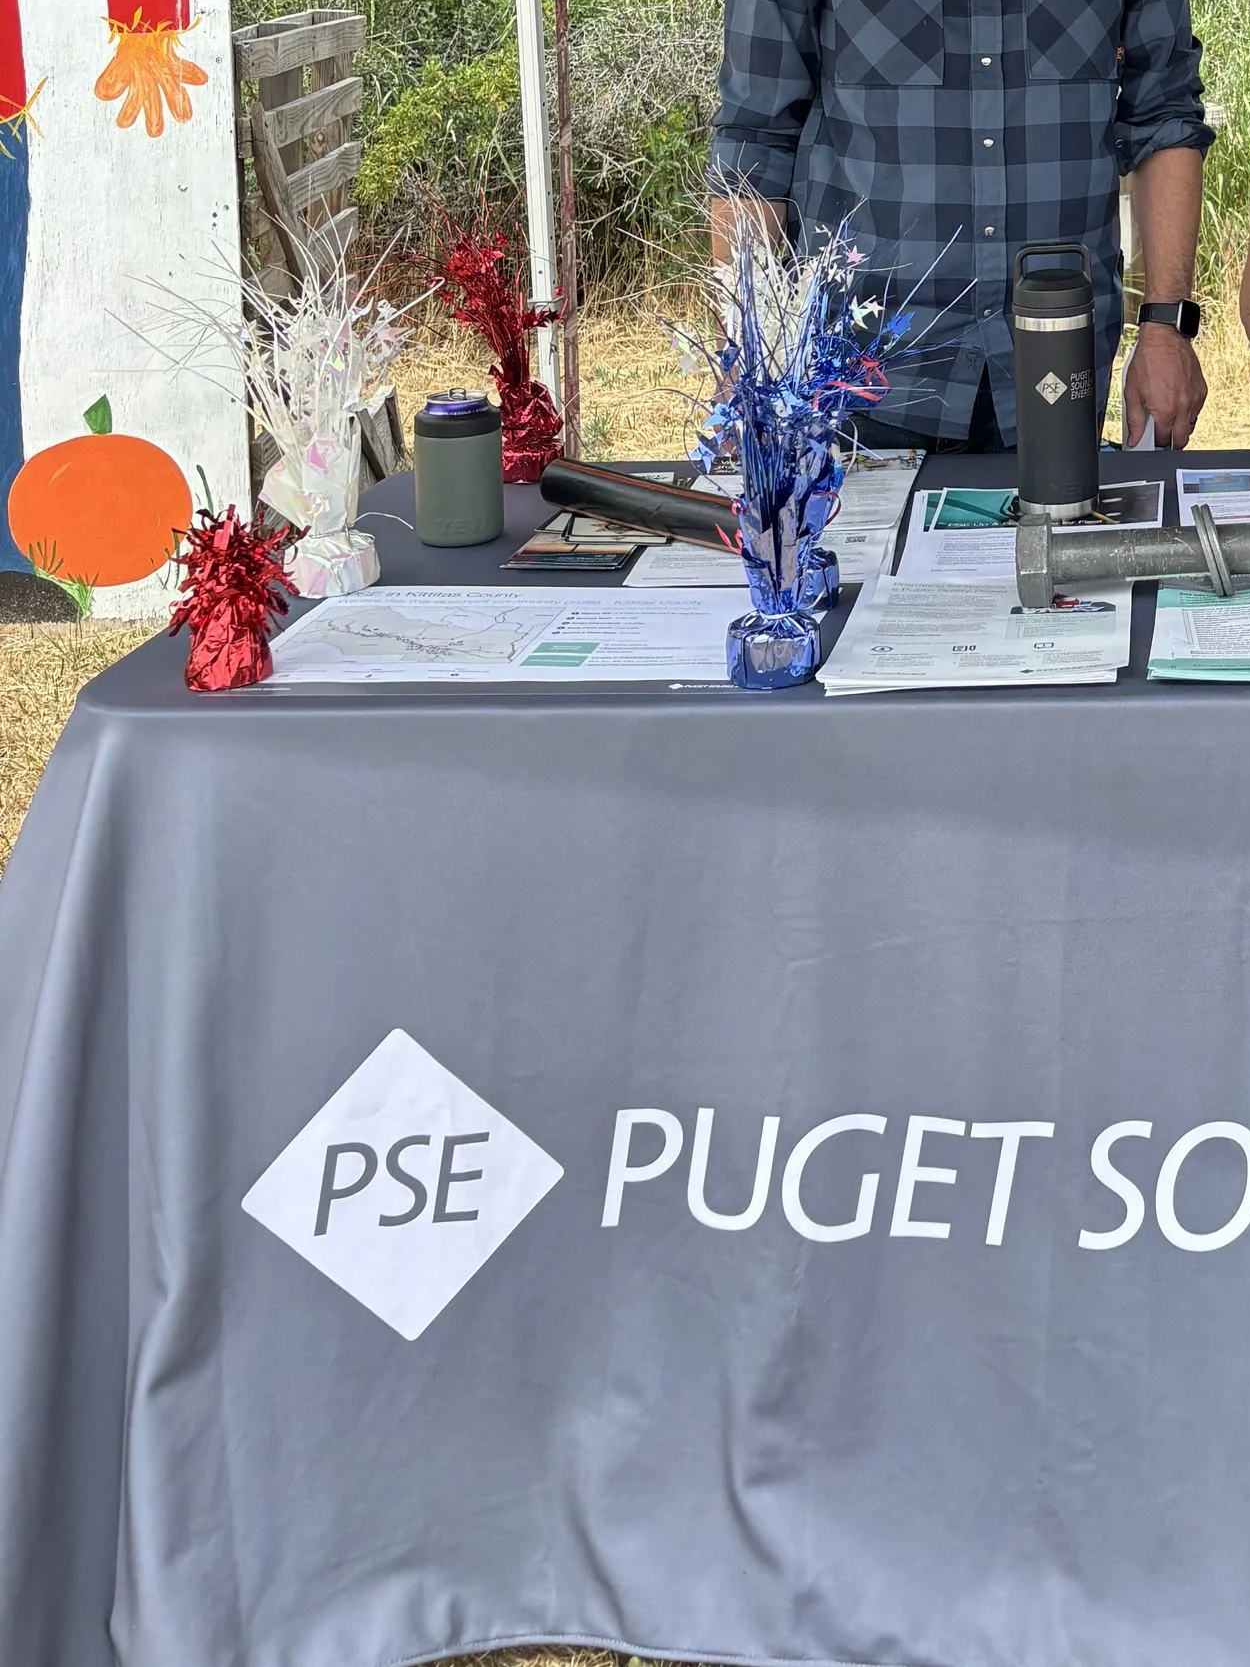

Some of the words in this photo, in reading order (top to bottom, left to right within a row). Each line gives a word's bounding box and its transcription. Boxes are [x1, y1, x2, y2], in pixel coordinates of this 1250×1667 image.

[1042, 382, 1061, 394] PSE
[313, 1131, 490, 1238] PSE
[602, 1108, 1054, 1246] PUGET
